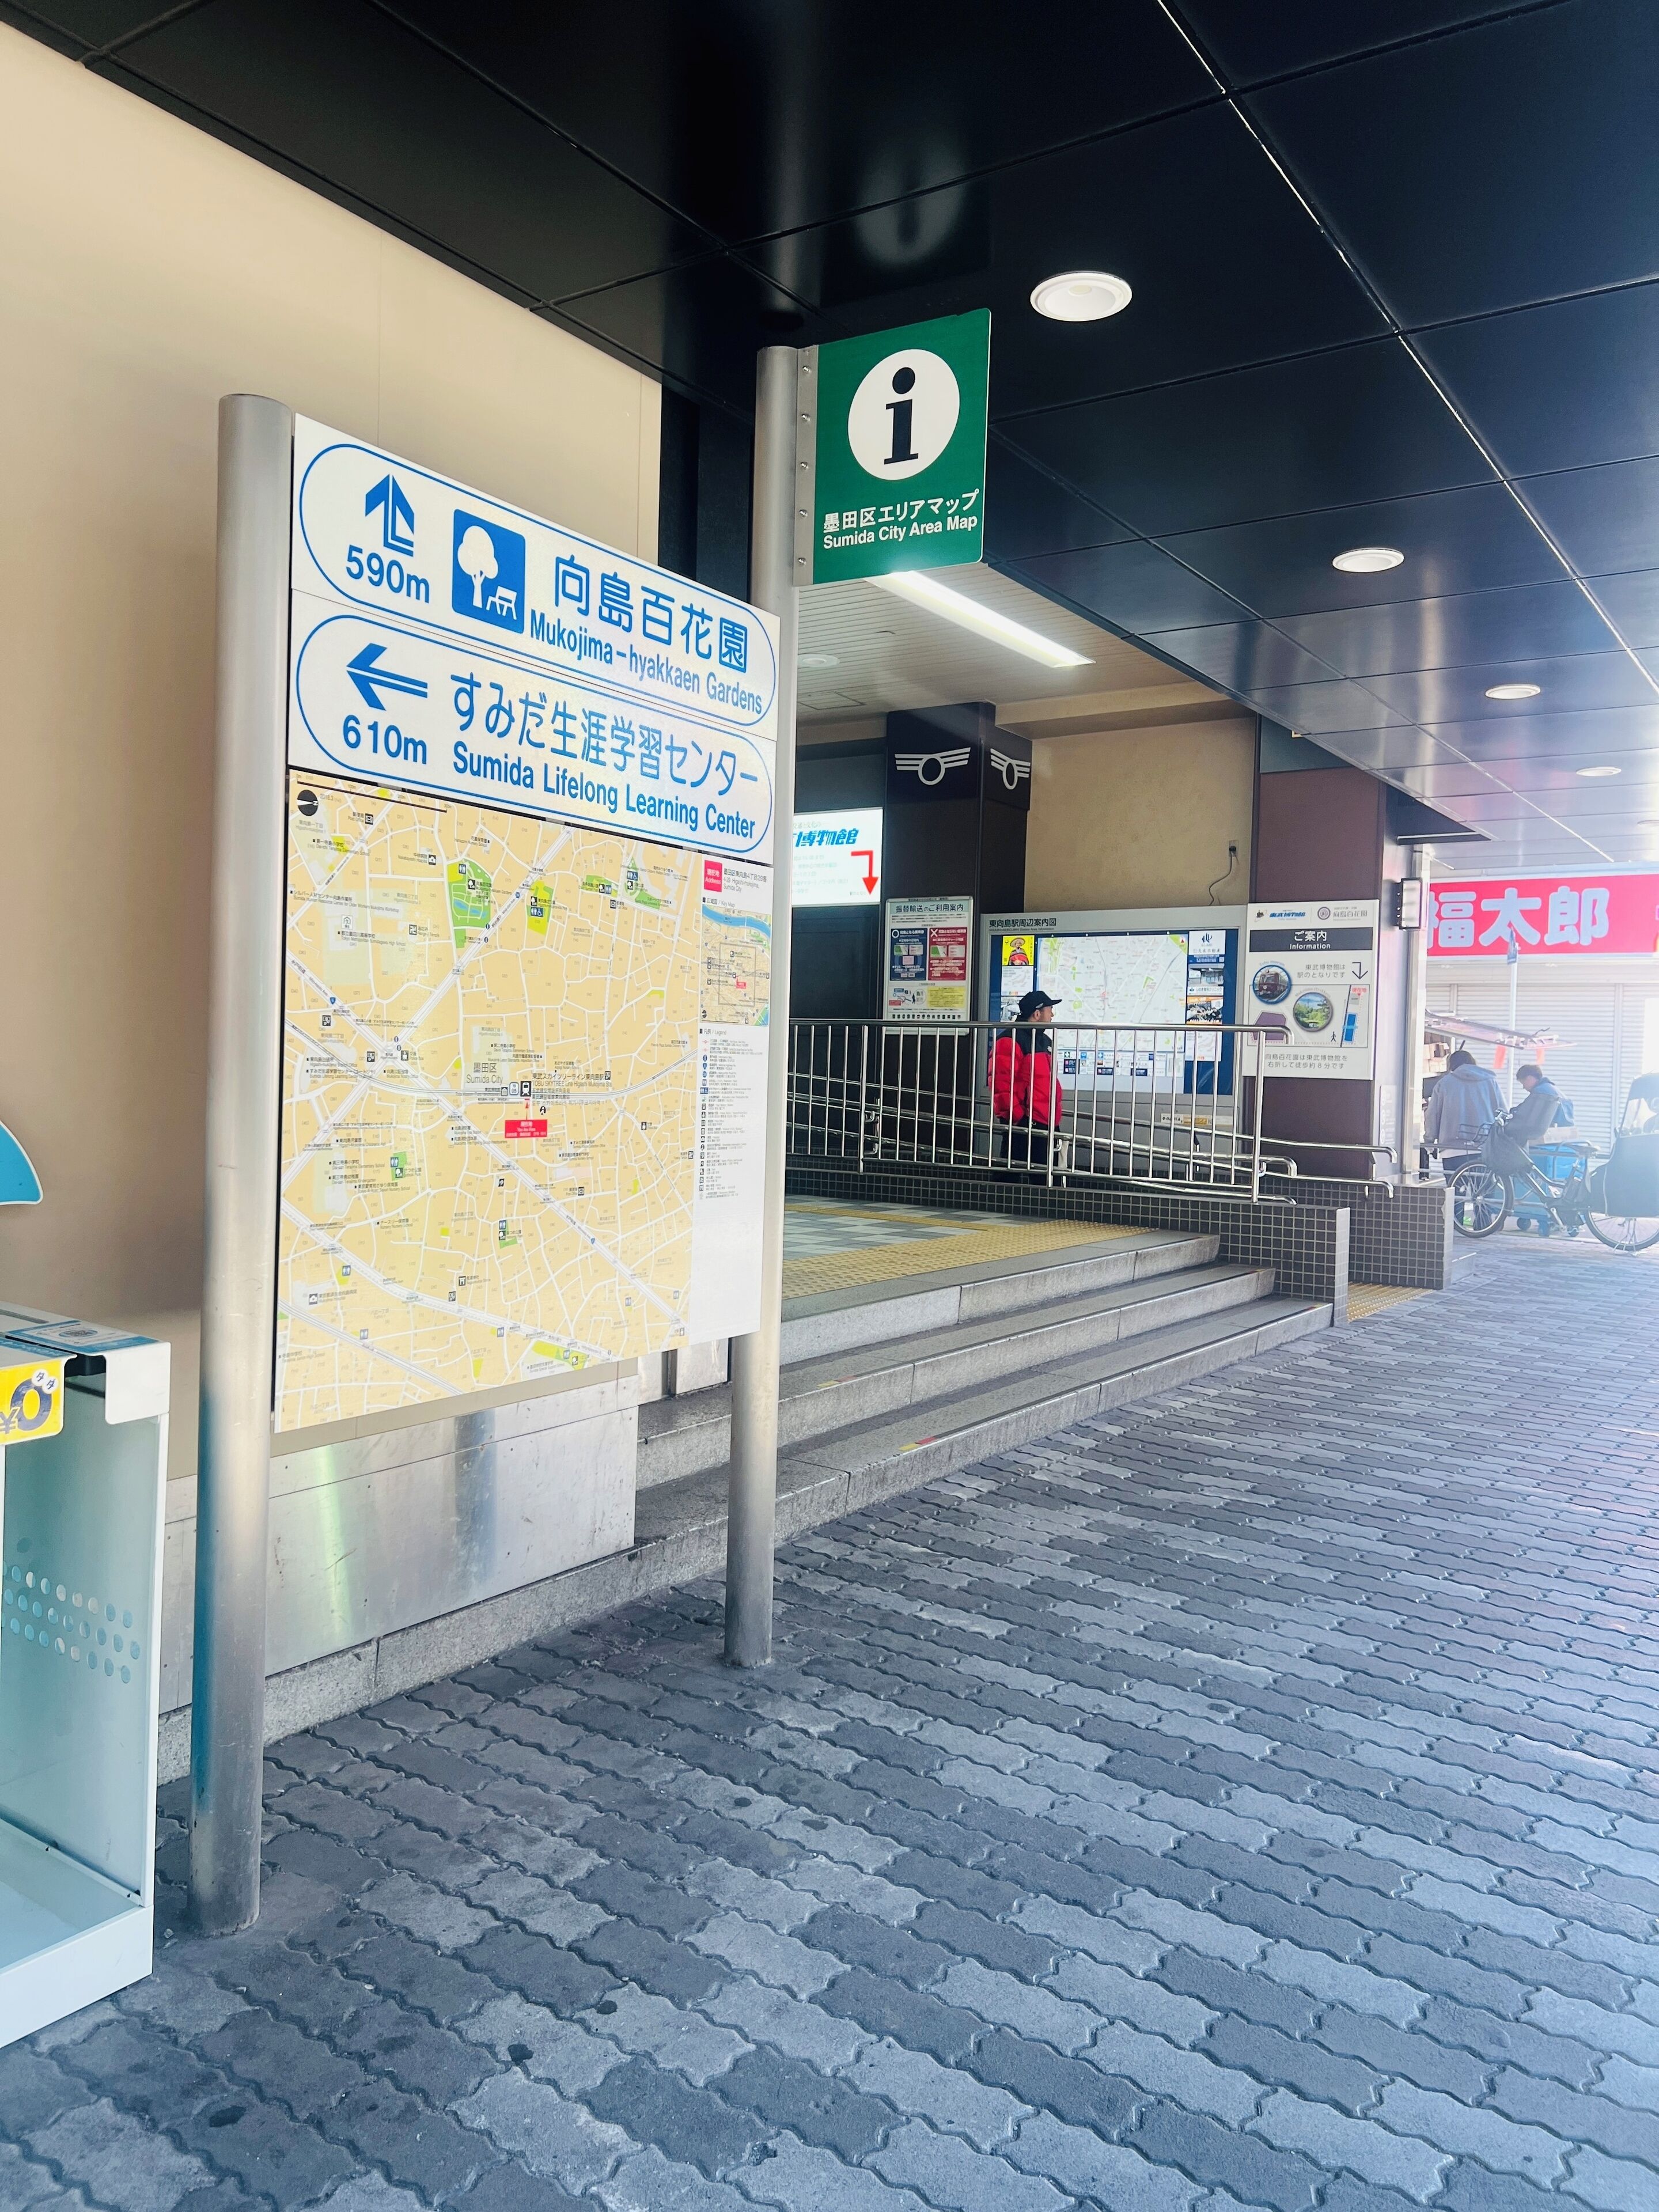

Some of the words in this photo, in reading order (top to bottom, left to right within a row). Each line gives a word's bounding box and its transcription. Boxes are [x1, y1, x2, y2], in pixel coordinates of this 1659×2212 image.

[823, 488, 980, 534] 墨田区エリアマップ
[823, 529, 875, 550] Sumida
[878, 524, 906, 543] City
[909, 521, 942, 537] Area
[946, 514, 978, 532] Map
[346, 544, 430, 604] 590m
[554, 554, 748, 674] 向島百花園
[706, 673, 763, 715] Gardens
[342, 714, 427, 764] 610m
[450, 672, 759, 797] すみだ生涯学習センター
[453, 742, 535, 789] Sumida
[543, 760, 619, 812] Lifelong
[626, 782, 699, 834] Learning
[705, 808, 756, 839] Center
[793, 828, 859, 847] 博物館
[896, 903, 964, 912] 振替輸送のご利用案内
[989, 918, 1056, 927] 東向島駅周辺案内図
[1429, 885, 1609, 949] 福太郎
[1294, 930, 1327, 942] ご案内
[467, 1074, 489, 1084] Sumida
[491, 1075, 503, 1085] City
